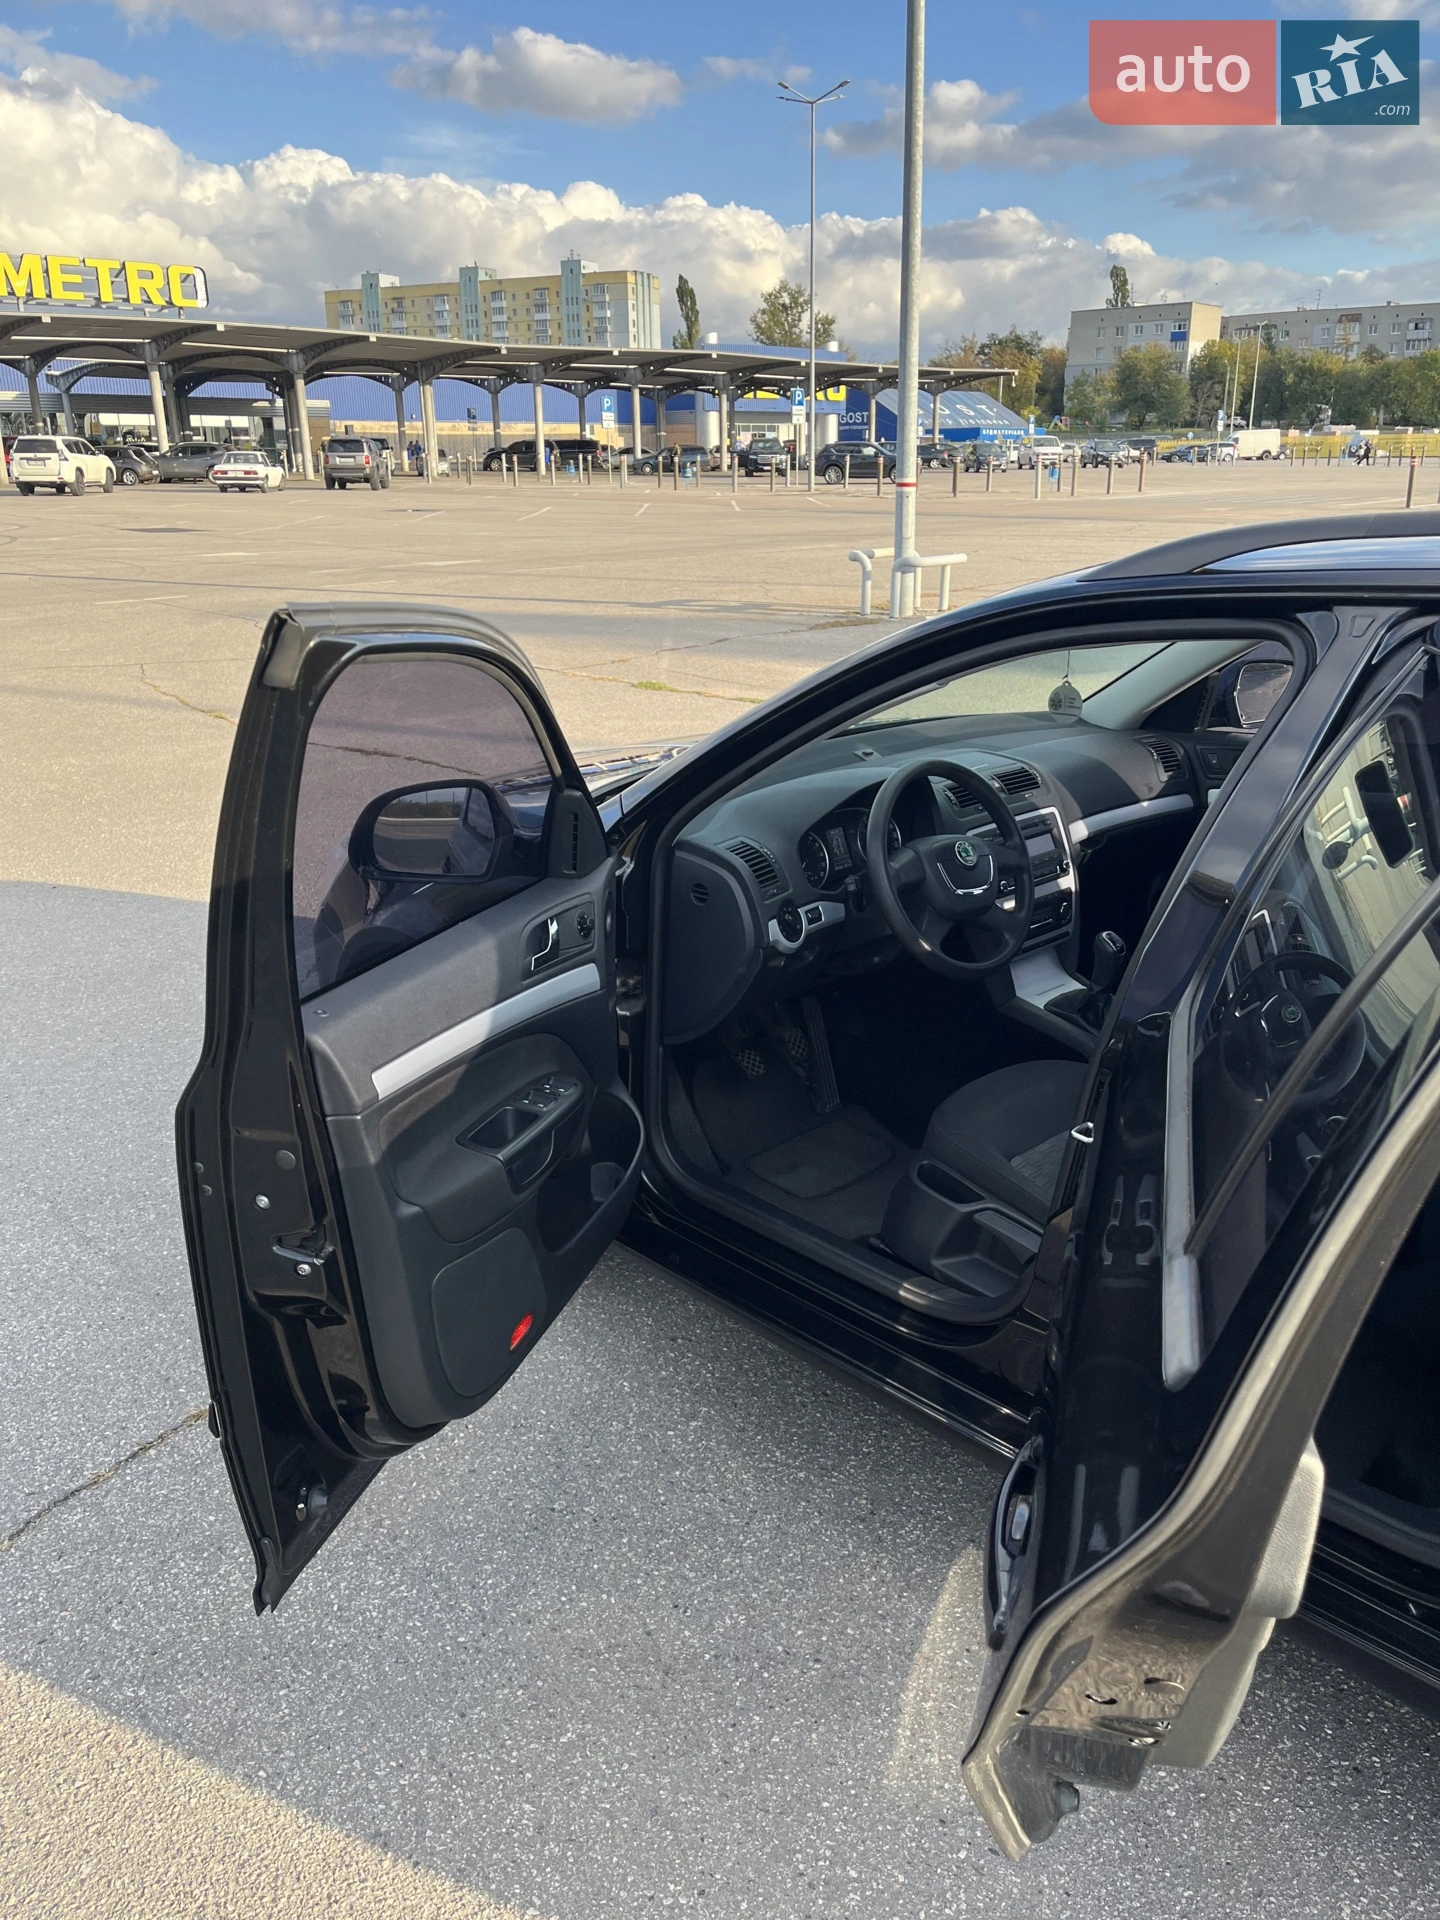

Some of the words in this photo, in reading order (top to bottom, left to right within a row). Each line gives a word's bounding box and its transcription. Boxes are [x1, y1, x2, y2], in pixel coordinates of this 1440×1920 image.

[0, 251, 208, 309] METRO
[603, 397, 611, 411] P
[795, 390, 803, 405] P
[839, 411, 869, 424] GOST
